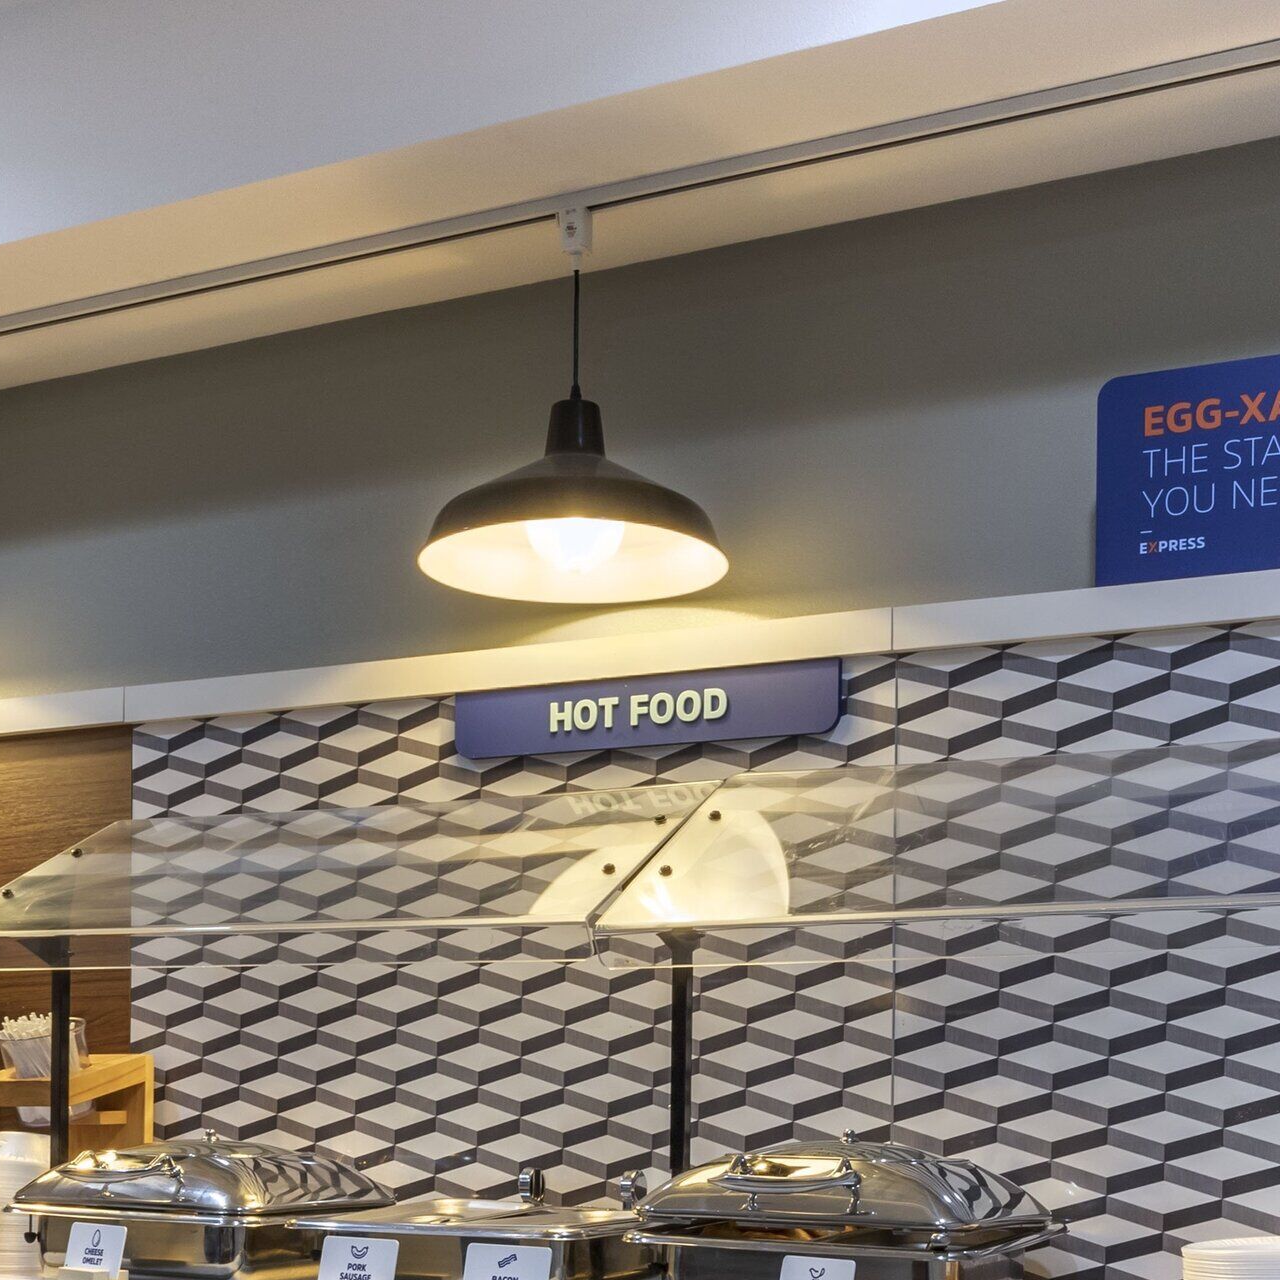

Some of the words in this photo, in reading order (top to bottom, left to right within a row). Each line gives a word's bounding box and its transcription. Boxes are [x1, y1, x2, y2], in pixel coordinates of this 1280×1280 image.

[1142, 442, 1209, 478] THE
[1142, 482, 1216, 518] YOU
[1139, 536, 1206, 555] EXPRESS
[549, 696, 619, 733] HOT
[629, 687, 729, 727] FOOD
[82, 1257, 103, 1265] OMELET
[84, 1248, 104, 1256] CHEESE
[347, 1263, 367, 1272] PORK
